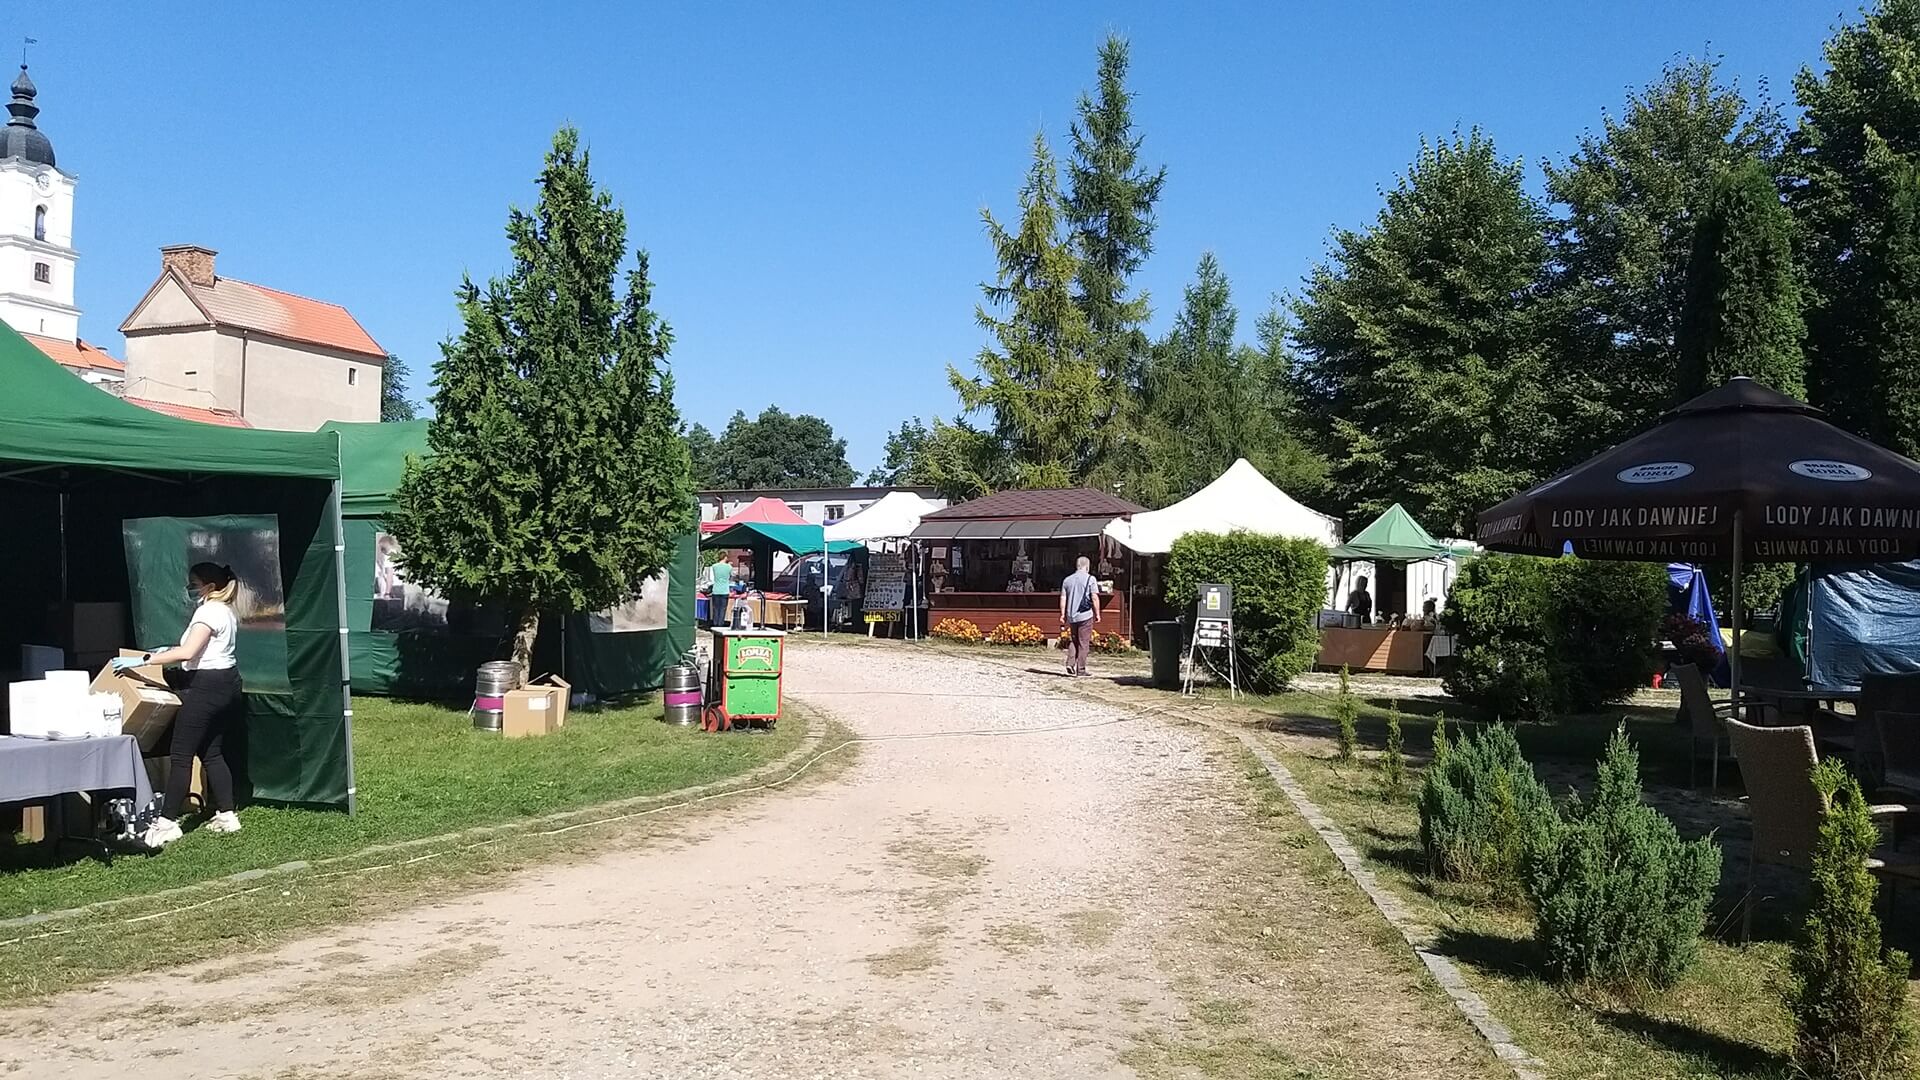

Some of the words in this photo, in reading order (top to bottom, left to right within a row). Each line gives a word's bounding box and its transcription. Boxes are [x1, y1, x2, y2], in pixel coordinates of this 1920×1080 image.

[1551, 508, 1595, 528] LODY
[1600, 507, 1632, 527] JAK
[1637, 505, 1718, 526] DAWNIEJ
[1765, 505, 1812, 525] LODY
[1818, 506, 1854, 526] JAK
[1860, 507, 1920, 528] DAWNI
